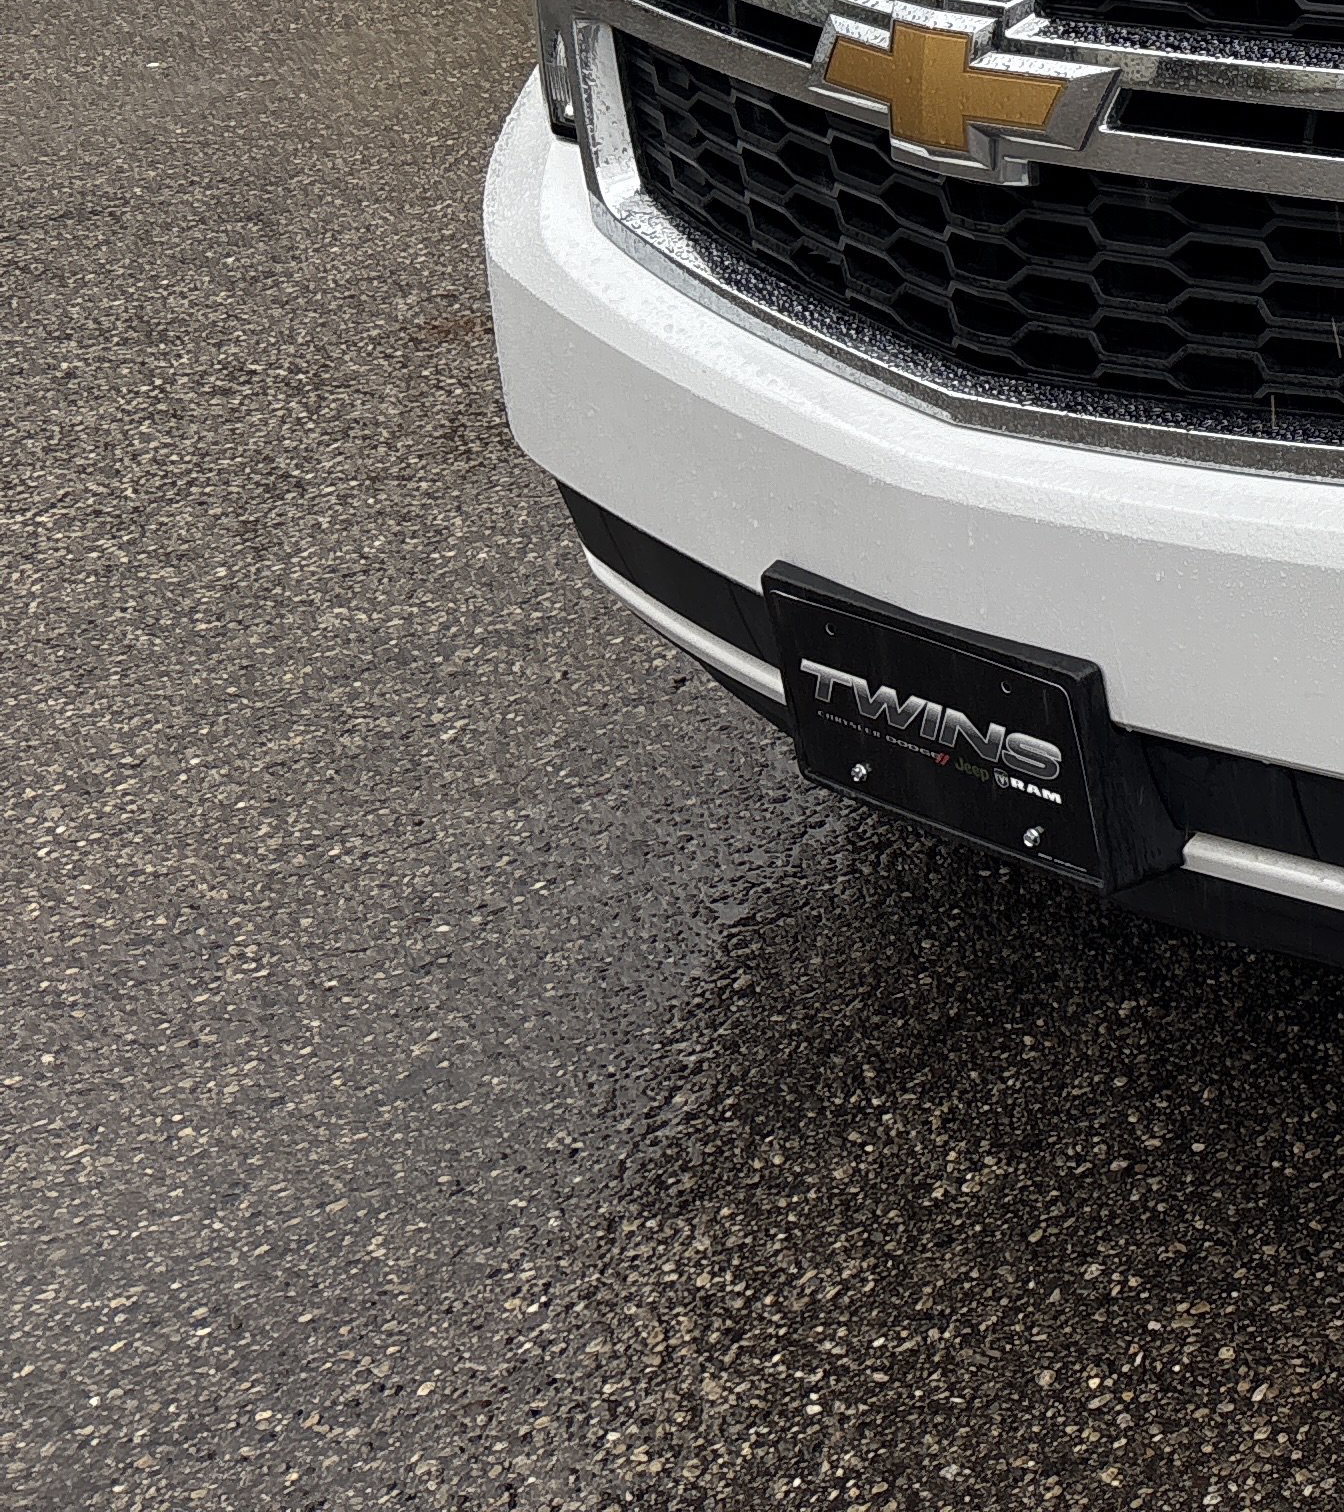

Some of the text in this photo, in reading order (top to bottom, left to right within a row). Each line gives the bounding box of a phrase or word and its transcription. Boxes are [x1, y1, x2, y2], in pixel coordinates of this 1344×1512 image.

[801, 658, 1062, 781] TWINS
[885, 735, 942, 762] DODGE
[955, 757, 990, 782] Jeep
[1010, 776, 1062, 804] RAM
